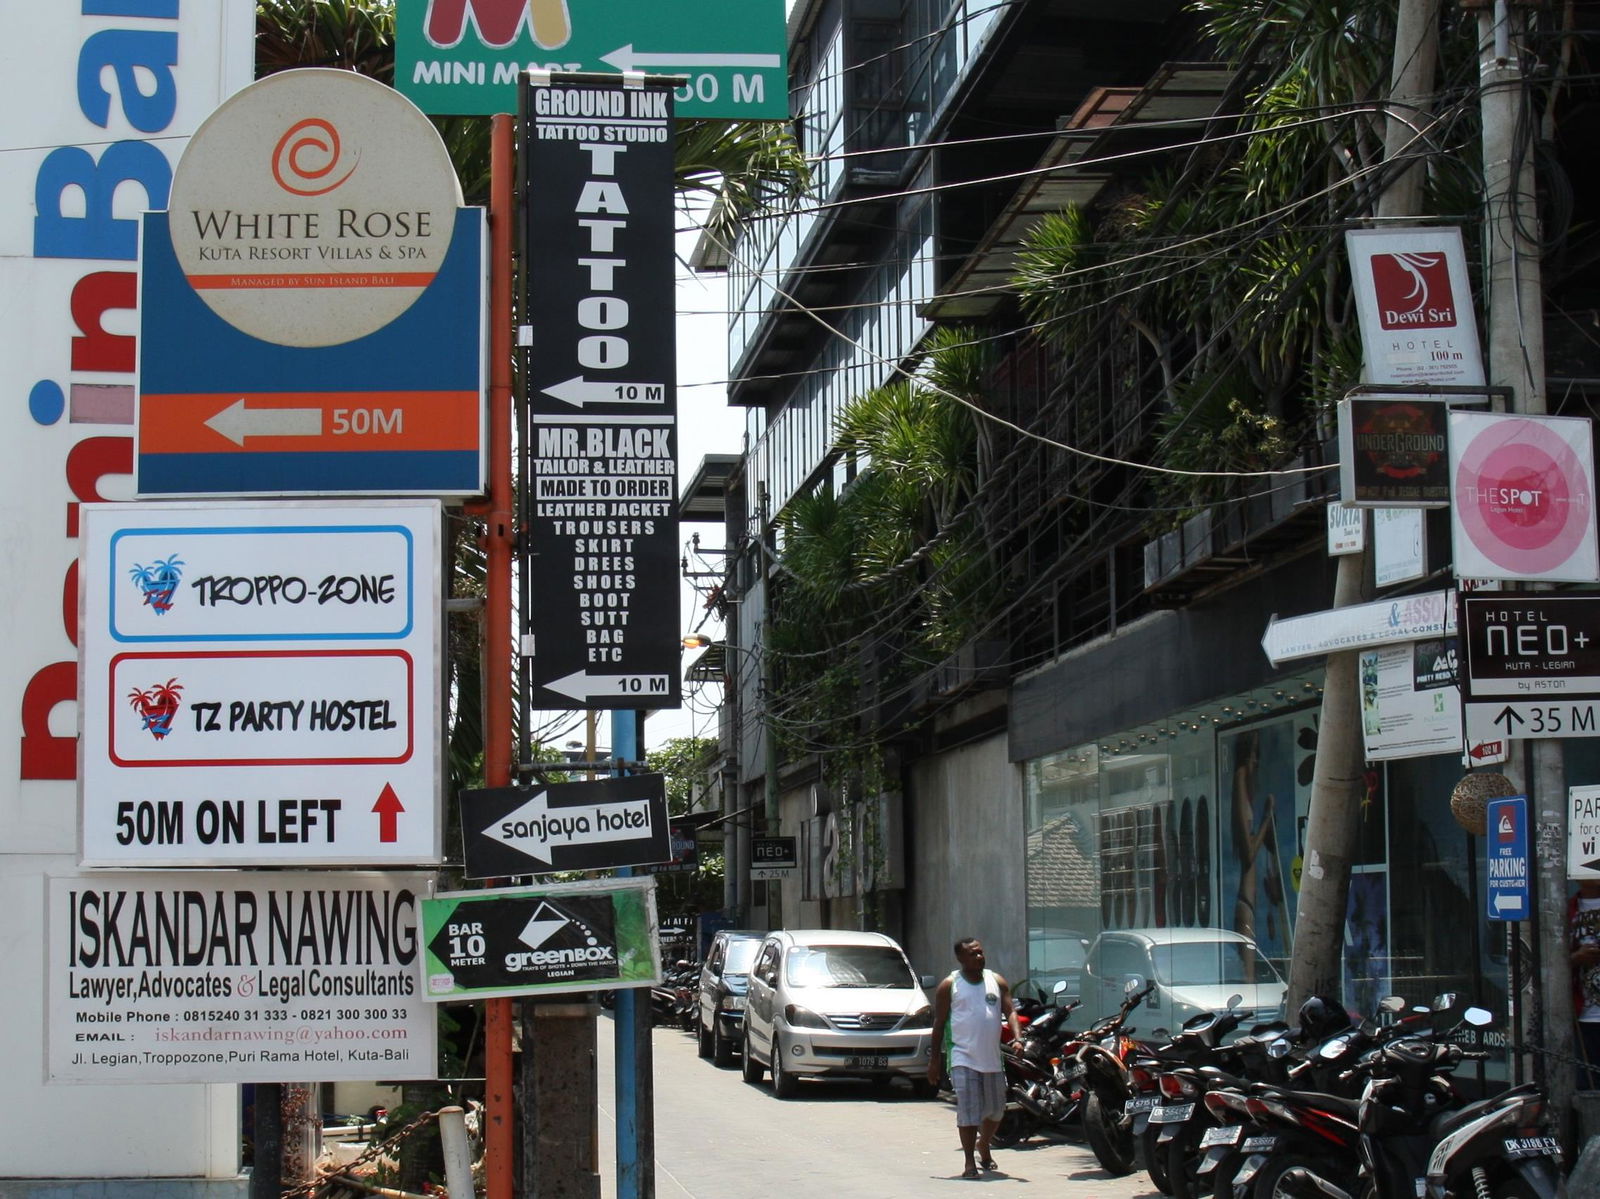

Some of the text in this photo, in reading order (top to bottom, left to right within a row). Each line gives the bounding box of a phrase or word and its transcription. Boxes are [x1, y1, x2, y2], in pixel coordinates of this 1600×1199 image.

[413, 61, 486, 86] MINI
[732, 74, 765, 103] M
[535, 88, 668, 118] GROUND INK
[33, 0, 179, 260] Ba
[536, 124, 668, 142] TATTOO STUDIO
[379, 246, 391, 259] &
[575, 143, 630, 369] TATTOO
[1385, 308, 1453, 325] Dewi Sri
[1393, 340, 1453, 351] HOTEL
[1431, 351, 1463, 361] 100 m
[615, 386, 661, 400] 10 M
[332, 408, 403, 435] 50M
[538, 428, 670, 458] MR.BLACK
[533, 459, 675, 475] TAILOR & LEATHER
[540, 480, 669, 497] MADE TO ORDER
[537, 503, 671, 517] LEATHER JACKET
[553, 521, 655, 535] TROUSERS
[575, 539, 634, 553] SKIRT
[574, 557, 635, 571] DREES
[573, 575, 636, 589] SHOES
[192, 574, 395, 607] TROPPO-ZONE
[580, 593, 630, 607] BOOT
[1389, 602, 1400, 627] &
[1486, 611, 1548, 622] HOTEL
[586, 630, 624, 644] BAG
[588, 648, 622, 662] ETC
[1505, 661, 1531, 671] KUTA
[1543, 661, 1575, 670] LEGIAN
[618, 678, 665, 692] 10 M
[1518, 680, 1566, 691] by ASTON
[191, 700, 397, 732] TZ PARTY HOSTEL
[1530, 706, 1595, 732] 35 M
[116, 799, 341, 845] 50M ON LEFT
[502, 804, 649, 843] sanjaya hotel
[1580, 823, 1594, 835] for
[1489, 857, 1525, 877] PARKING
[69, 889, 418, 968] ISKANDAR NAWING
[448, 922, 484, 936] BAR
[449, 935, 486, 958] 10
[451, 957, 486, 967] METER
[547, 970, 574, 978] LEGIAN
[237, 974, 256, 998] &
[258, 969, 306, 1004] Legal
[309, 968, 414, 997] Consultants
[76, 1011, 122, 1023] Mobile
[126, 1011, 170, 1022] Phone
[184, 1010, 240, 1021] 0815240
[244, 1010, 260, 1021] 31
[264, 1010, 288, 1021] 333
[300, 1009, 332, 1020] 0821
[336, 1009, 360, 1020] 300
[364, 1009, 388, 1020] 300
[392, 1008, 408, 1019] 33
[75, 1033, 125, 1042] EMAIL
[155, 1027, 408, 1045] iskandarnawing@yahoo.com
[72, 1053, 88, 1065] Jl.
[260, 1051, 300, 1062] Rama
[305, 1050, 344, 1063] Hotel,
[348, 1049, 409, 1061] Kuta-Bali
[1505, 1139, 1520, 1151] DK
